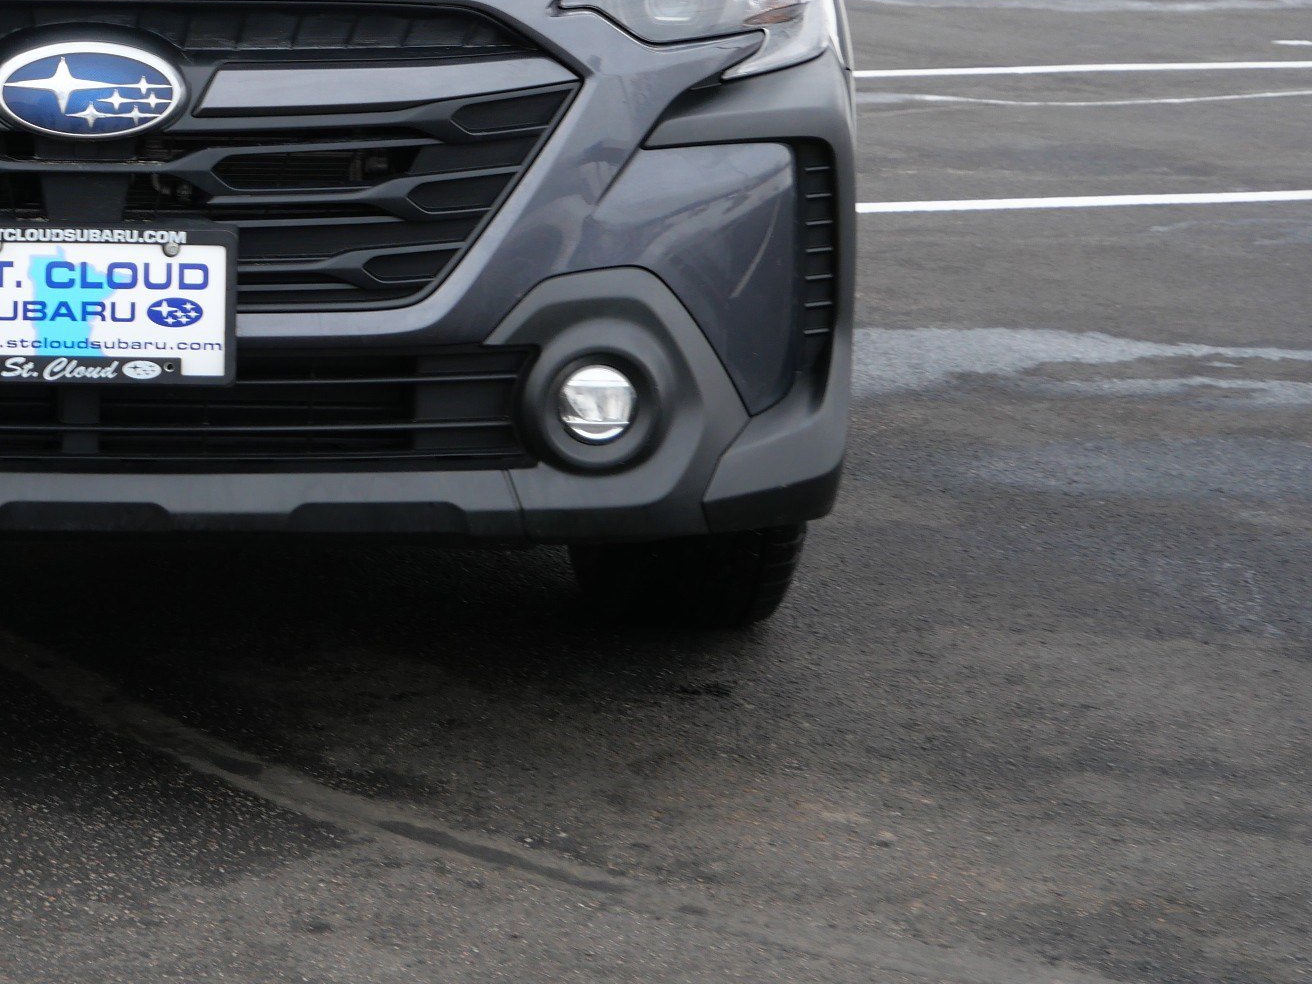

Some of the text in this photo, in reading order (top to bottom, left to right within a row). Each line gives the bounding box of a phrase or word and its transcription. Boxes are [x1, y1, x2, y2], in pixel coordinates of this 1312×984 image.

[45, 261, 209, 290] CLOUD
[0, 356, 119, 381] St. Cloud
